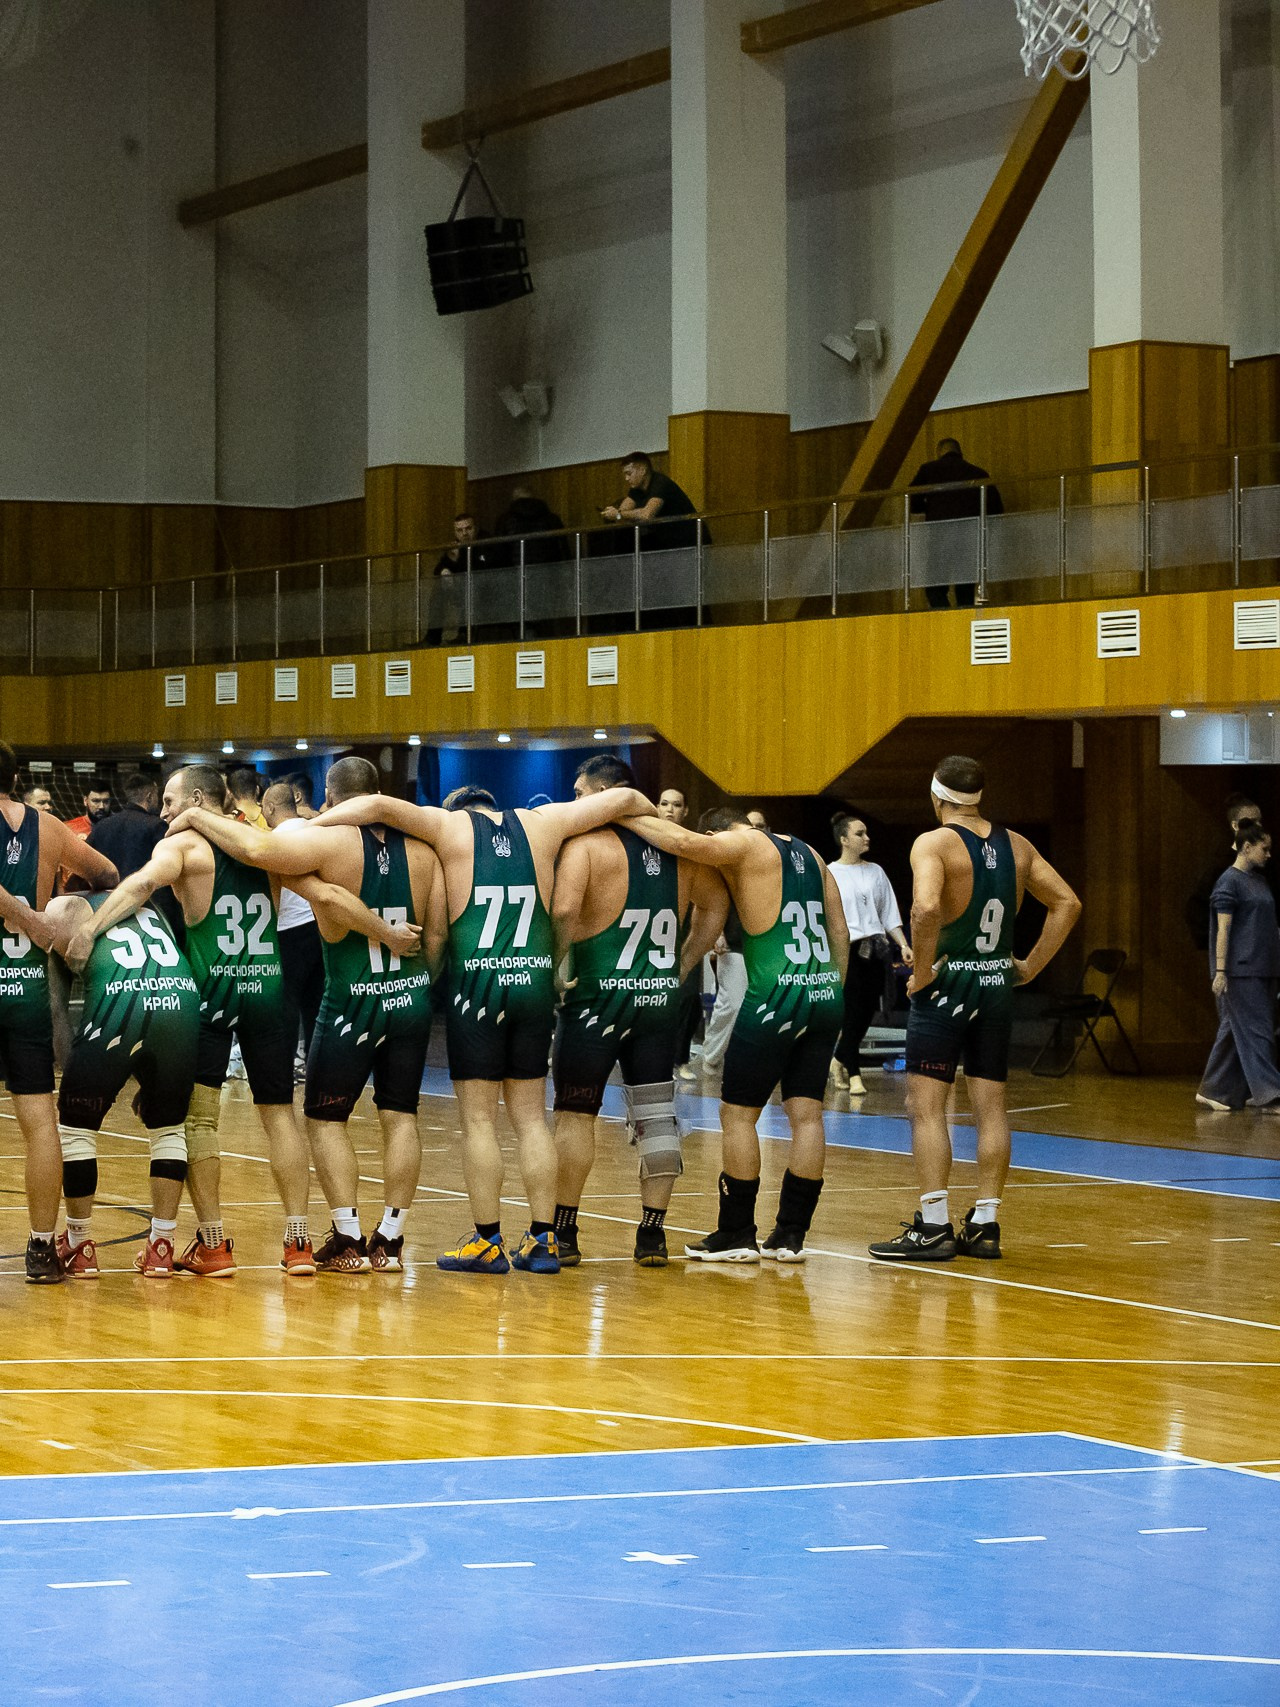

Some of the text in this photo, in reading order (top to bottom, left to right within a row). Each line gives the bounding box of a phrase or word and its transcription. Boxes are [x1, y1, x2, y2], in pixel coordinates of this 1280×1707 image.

[214, 893, 274, 955] 32
[474, 885, 536, 949] 77
[975, 898, 1005, 954] 9
[105, 907, 180, 970] 55
[615, 908, 677, 969] 79
[781, 901, 831, 965] 35
[464, 955, 552, 972] КРАСНОЯРСКИЙ
[236, 980, 263, 994] КРАЙ
[350, 971, 431, 996] КРАСНОЯРСКИЙ
[497, 971, 532, 986] КРАЙ
[979, 972, 1005, 987] КРАЙ
[143, 993, 181, 1011] КРАЙ
[381, 992, 413, 1012] КРАЙ
[634, 992, 668, 1007] КРАЙ
[808, 986, 835, 1003] КРАЙ
